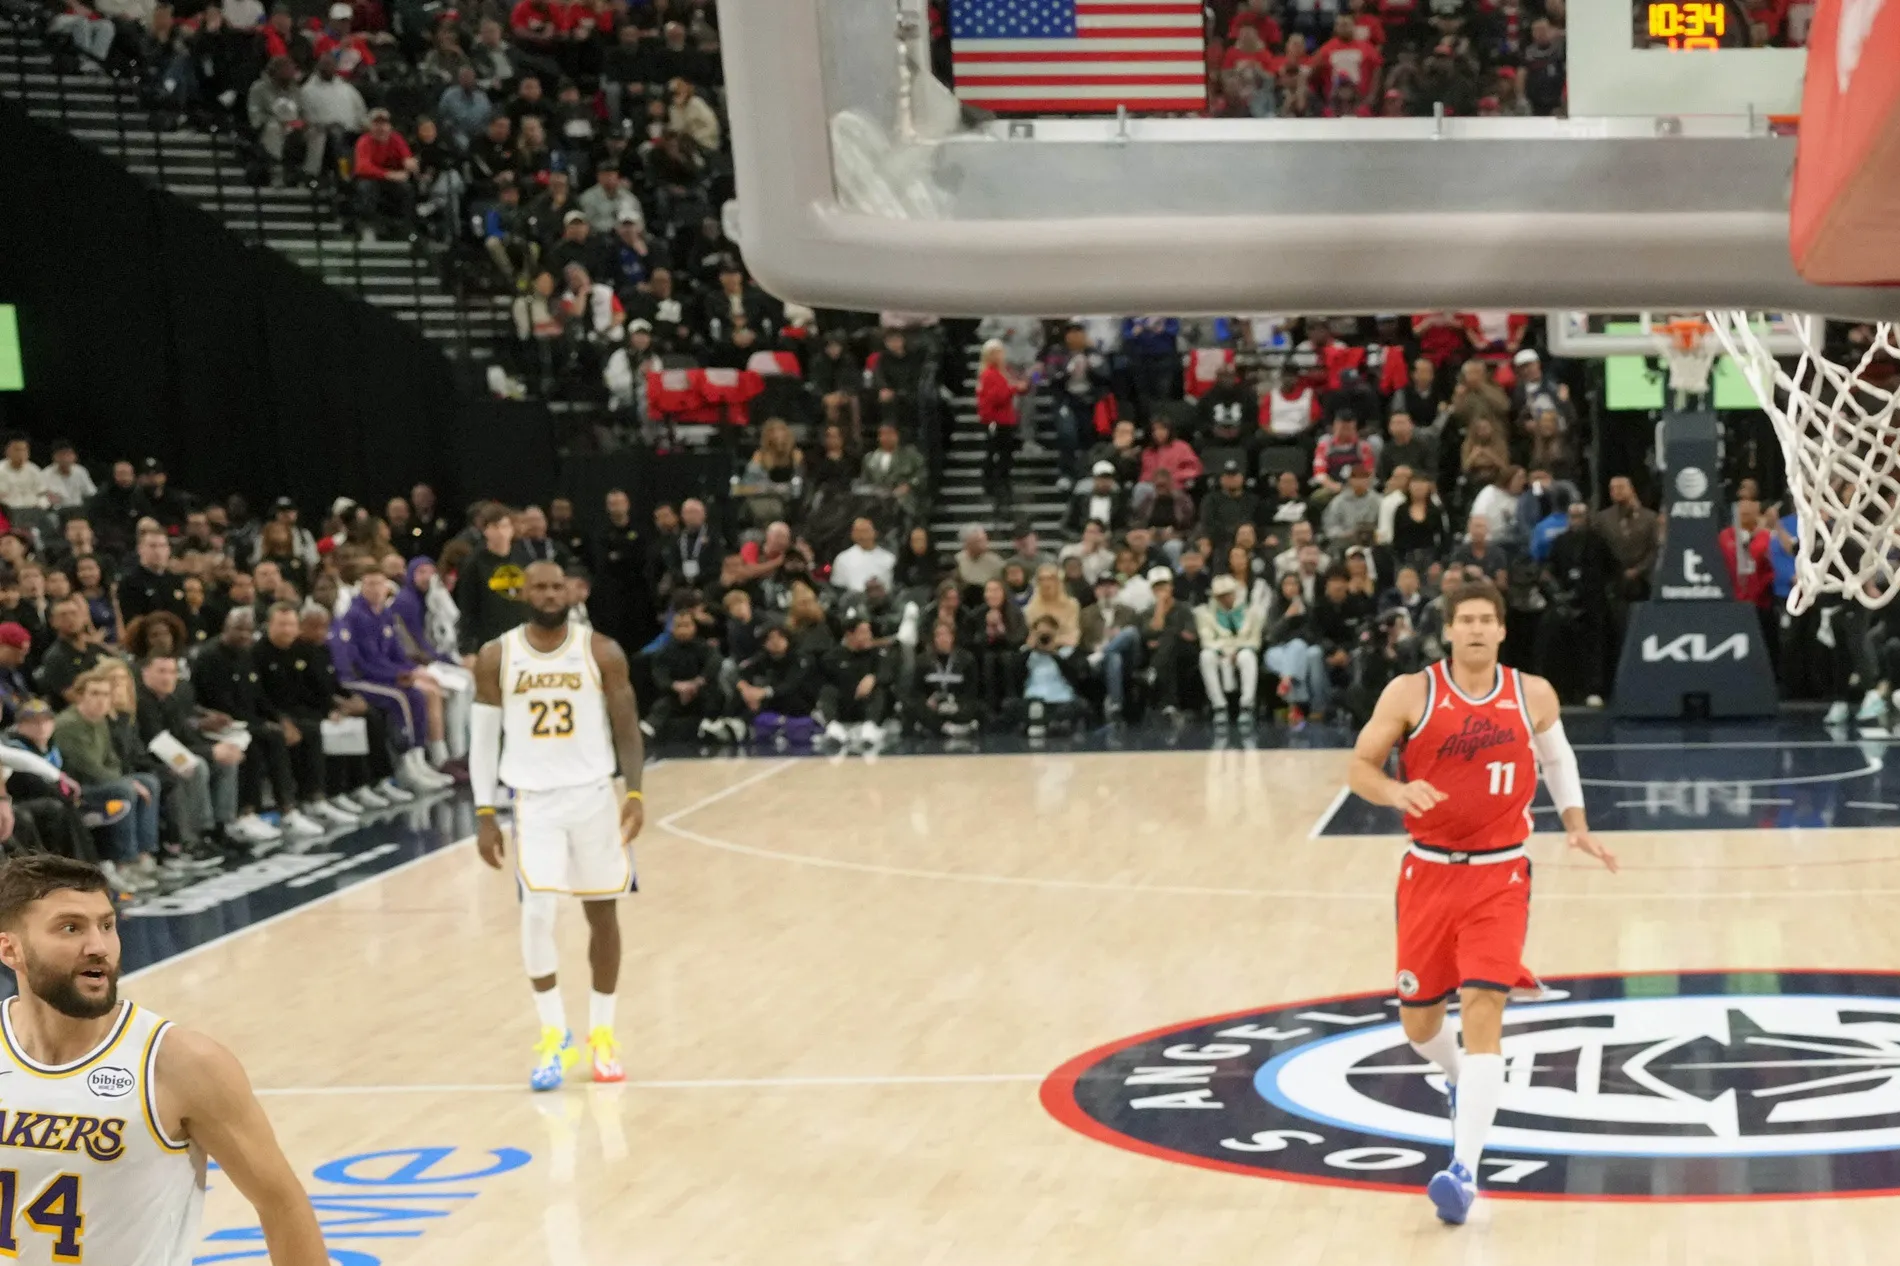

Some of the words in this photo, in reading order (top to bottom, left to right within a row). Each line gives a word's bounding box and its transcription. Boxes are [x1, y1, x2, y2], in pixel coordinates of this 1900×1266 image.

[1649, 3, 1725, 36] 10:34
[513, 670, 583, 694] LAKERS
[529, 699, 575, 739] 23
[1485, 761, 1516, 795] 11
[92, 1074, 132, 1089] bibigo
[0, 1168, 86, 1265] 14
